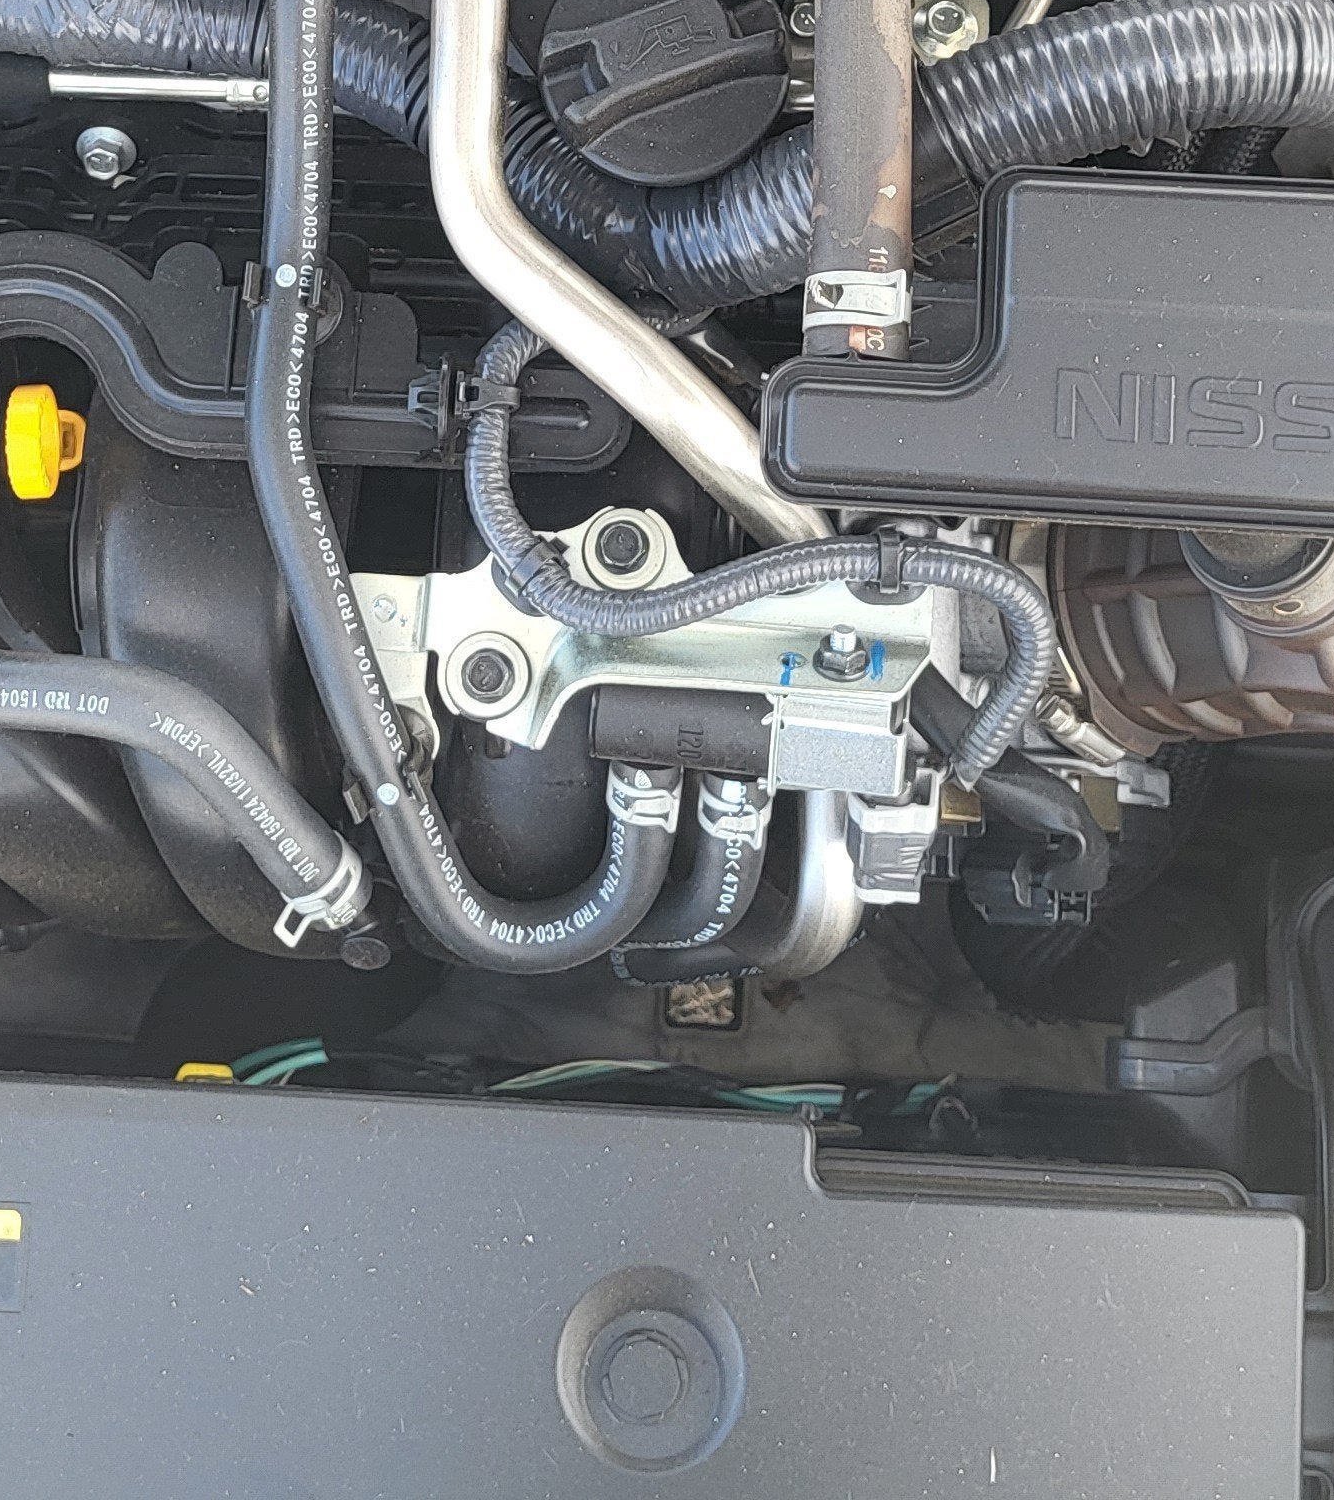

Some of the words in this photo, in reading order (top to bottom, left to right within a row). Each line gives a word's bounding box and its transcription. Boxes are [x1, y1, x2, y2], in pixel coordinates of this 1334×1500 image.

[296, 159, 321, 299] TRD>ECO<4704
[285, 311, 311, 464] TRD>ECO<4704
[299, 474, 359, 634] TRD>ECO<4704
[79, 693, 109, 714] DOT
[151, 712, 209, 758] >EPDM<
[677, 725, 704, 760] 120
[207, 748, 251, 800] 11/32VL
[245, 796, 285, 840] 150424
[295, 857, 321, 882] DOT
[421, 803, 493, 928] TRD>ECO<4704
[488, 901, 601, 945] TRD>ECO<4704
